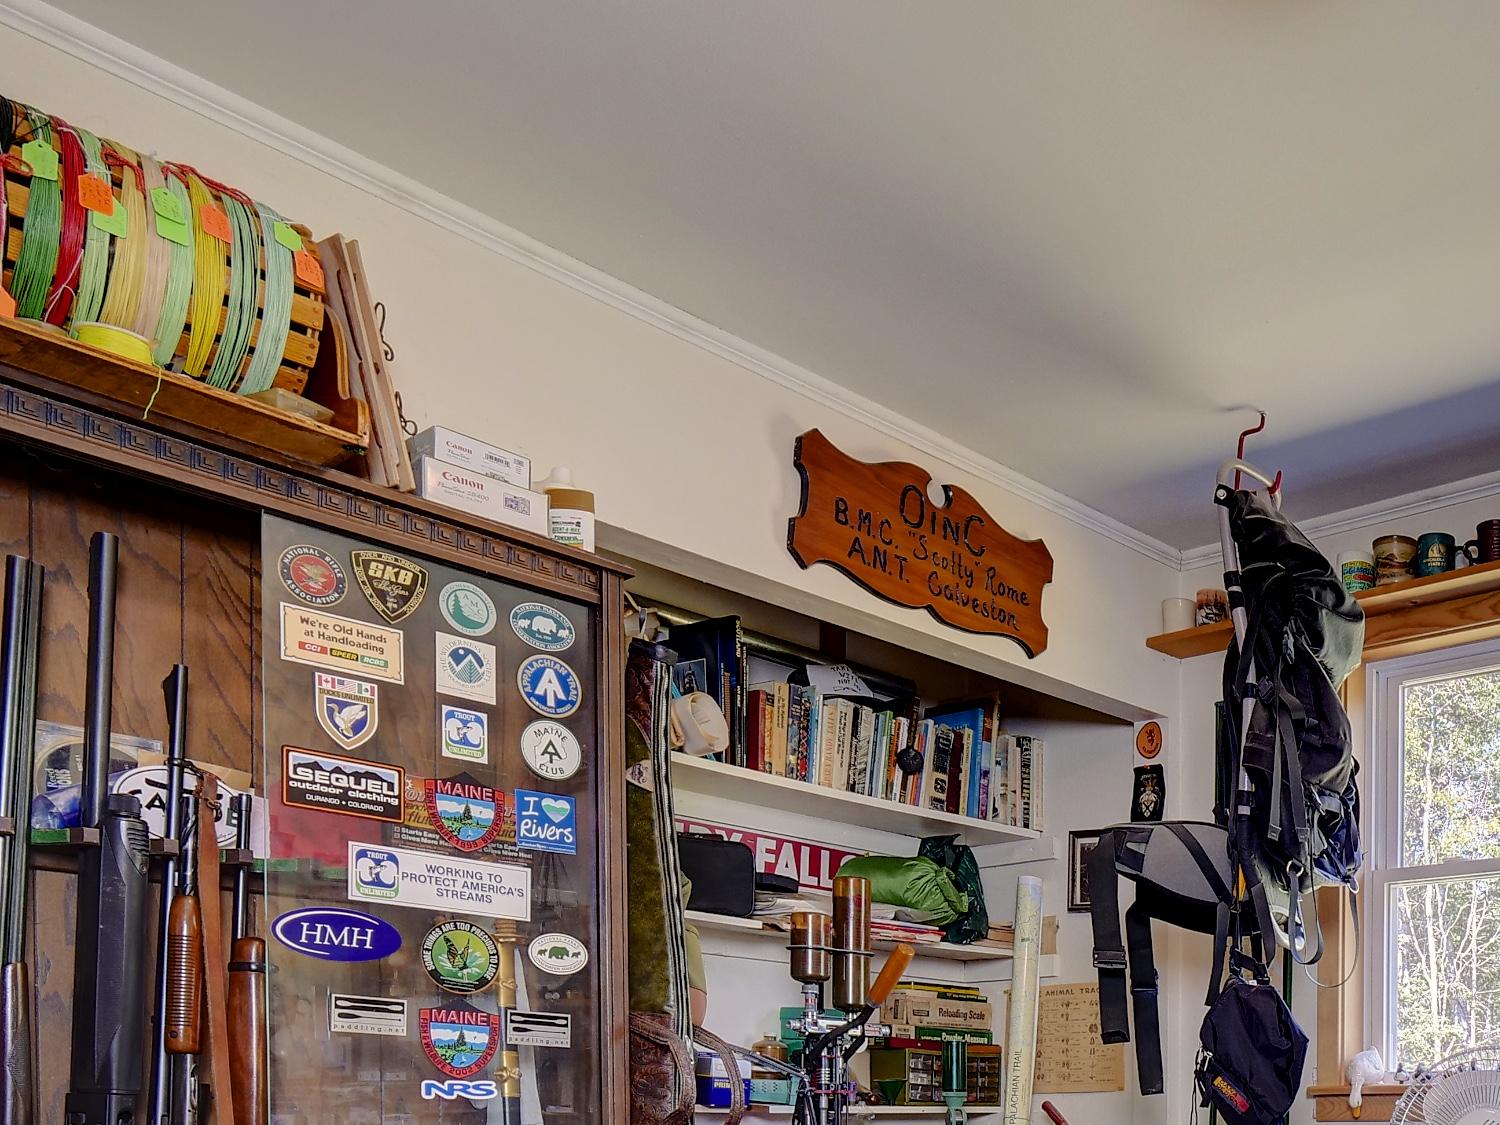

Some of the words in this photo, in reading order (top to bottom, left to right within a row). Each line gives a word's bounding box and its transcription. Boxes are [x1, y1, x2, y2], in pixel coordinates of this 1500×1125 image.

[445, 440, 473, 455] Canon
[442, 471, 485, 491] Canon
[899, 483, 986, 558] OINC
[282, 546, 321, 565] NATIONAL
[324, 556, 344, 578] RIFLE
[368, 561, 414, 585] SKB
[284, 578, 341, 605] ASSOCIATION
[984, 565, 1031, 607] Rome
[299, 615, 329, 630] We're
[333, 623, 353, 636] Old
[356, 626, 388, 644] Hands
[735, 619, 743, 658] SCOTLAND
[303, 628, 314, 639] at
[317, 630, 385, 656] Handloading
[304, 642, 322, 653] CCI
[331, 649, 358, 661] SPEER
[522, 657, 568, 693] APPALACHIAN
[566, 673, 578, 702] TRAIL
[319, 687, 340, 698] DUCKS
[341, 691, 376, 704] UNLIMITED
[453, 711, 476, 722] TROUT
[533, 727, 568, 743] MAINE
[538, 763, 565, 776] CLUB
[295, 766, 395, 796] SEQUEL
[436, 780, 494, 801] MAINE
[288, 780, 344, 795] outdoor
[348, 790, 400, 806] clothing
[305, 793, 341, 806] DURANGO
[347, 800, 384, 813] COLORADO
[521, 796, 539, 816] I
[520, 818, 573, 843] Rivers
[455, 837, 478, 849] 1999
[366, 850, 388, 861] TROUT
[755, 836, 857, 889] FALL
[425, 863, 484, 881] WORKING
[486, 872, 503, 884] TO
[359, 886, 396, 898] UNLIMITED
[401, 871, 459, 889] PROTECT
[461, 879, 525, 898] AMERICA'S
[435, 887, 493, 905] STREAMS
[298, 922, 374, 949] HMH
[441, 921, 457, 932] ARE
[456, 921, 471, 932] TOO
[423, 927, 443, 951] THINGS
[470, 925, 497, 955] PRECIOUS
[422, 950, 436, 972] SOME
[483, 963, 498, 981] LOSE
[1044, 987, 1075, 998] ANIMAL
[431, 1009, 488, 1026] MAINE
[938, 1007, 968, 1021] Reloading
[968, 1009, 986, 1021] Scale
[333, 1023, 406, 1034] paddling.net
[424, 1041, 447, 1070] WILDLIFE
[449, 1066, 474, 1076] 2002
[474, 1021, 500, 1071] SUPERSPORT
[508, 1035, 569, 1046] paddling.net
[1013, 1048, 1023, 1072] TRAIL
[424, 1082, 496, 1098] NRS
